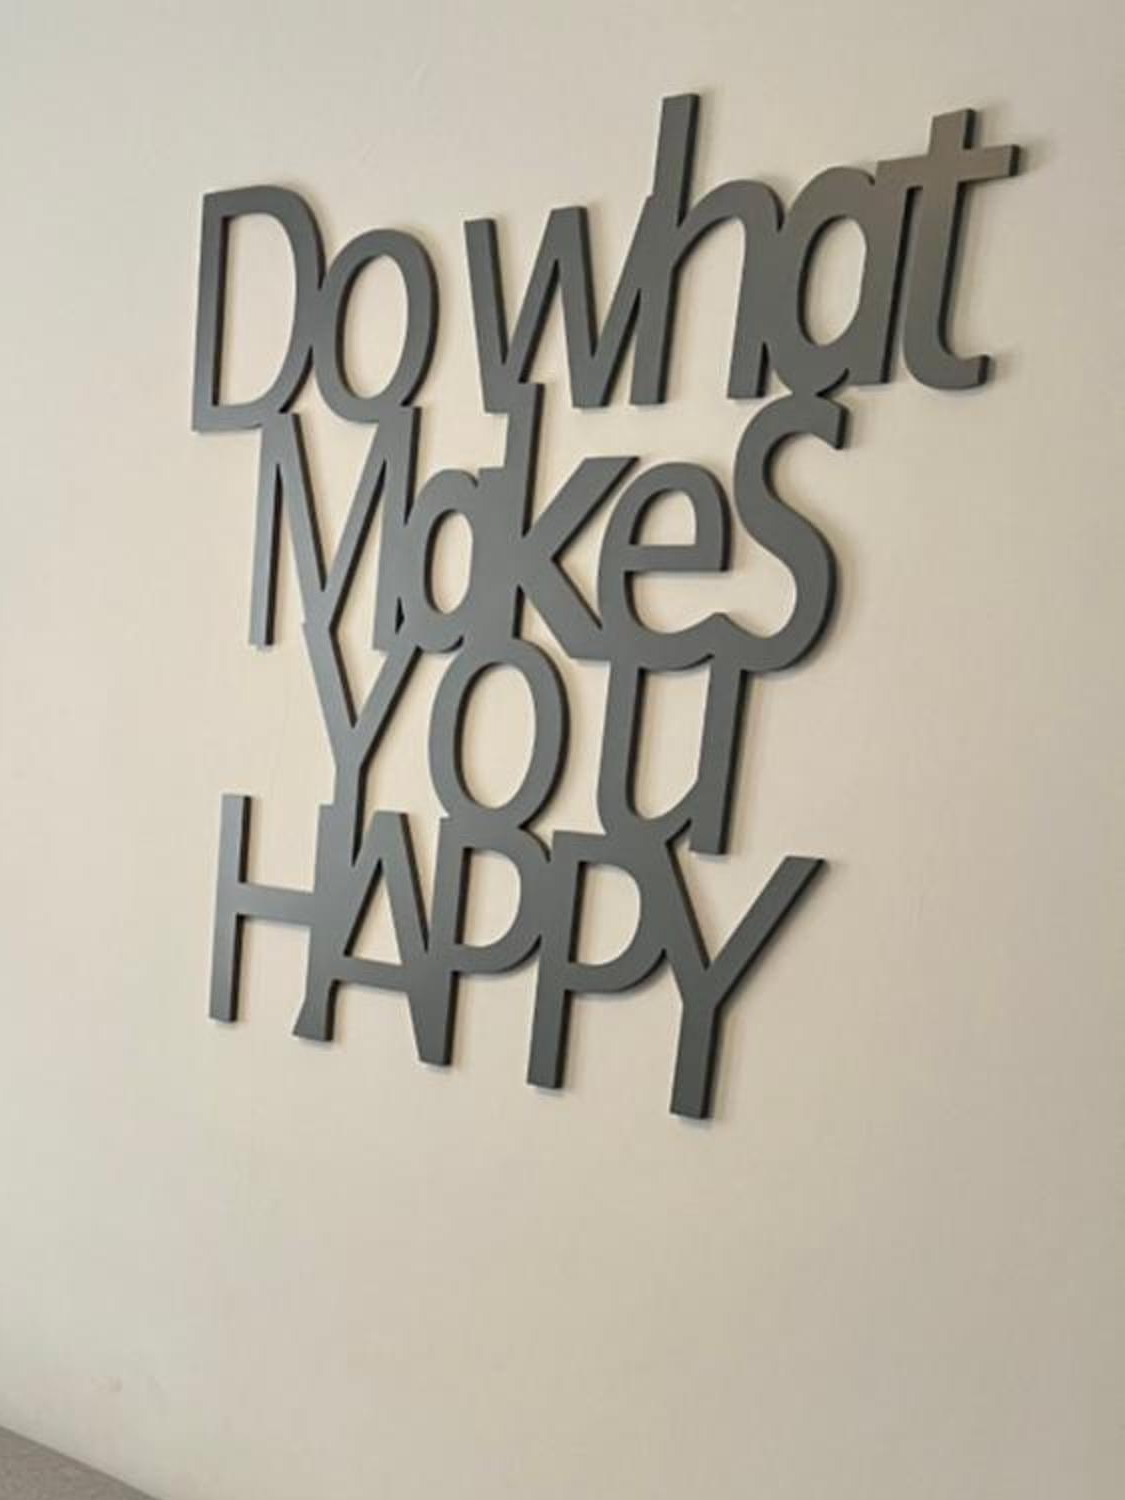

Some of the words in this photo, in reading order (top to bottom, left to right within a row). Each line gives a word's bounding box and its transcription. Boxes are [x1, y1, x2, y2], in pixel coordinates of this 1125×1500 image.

[192, 184, 440, 432] Do
[463, 92, 1021, 413] what
[209, 793, 829, 1120] HAPPY
